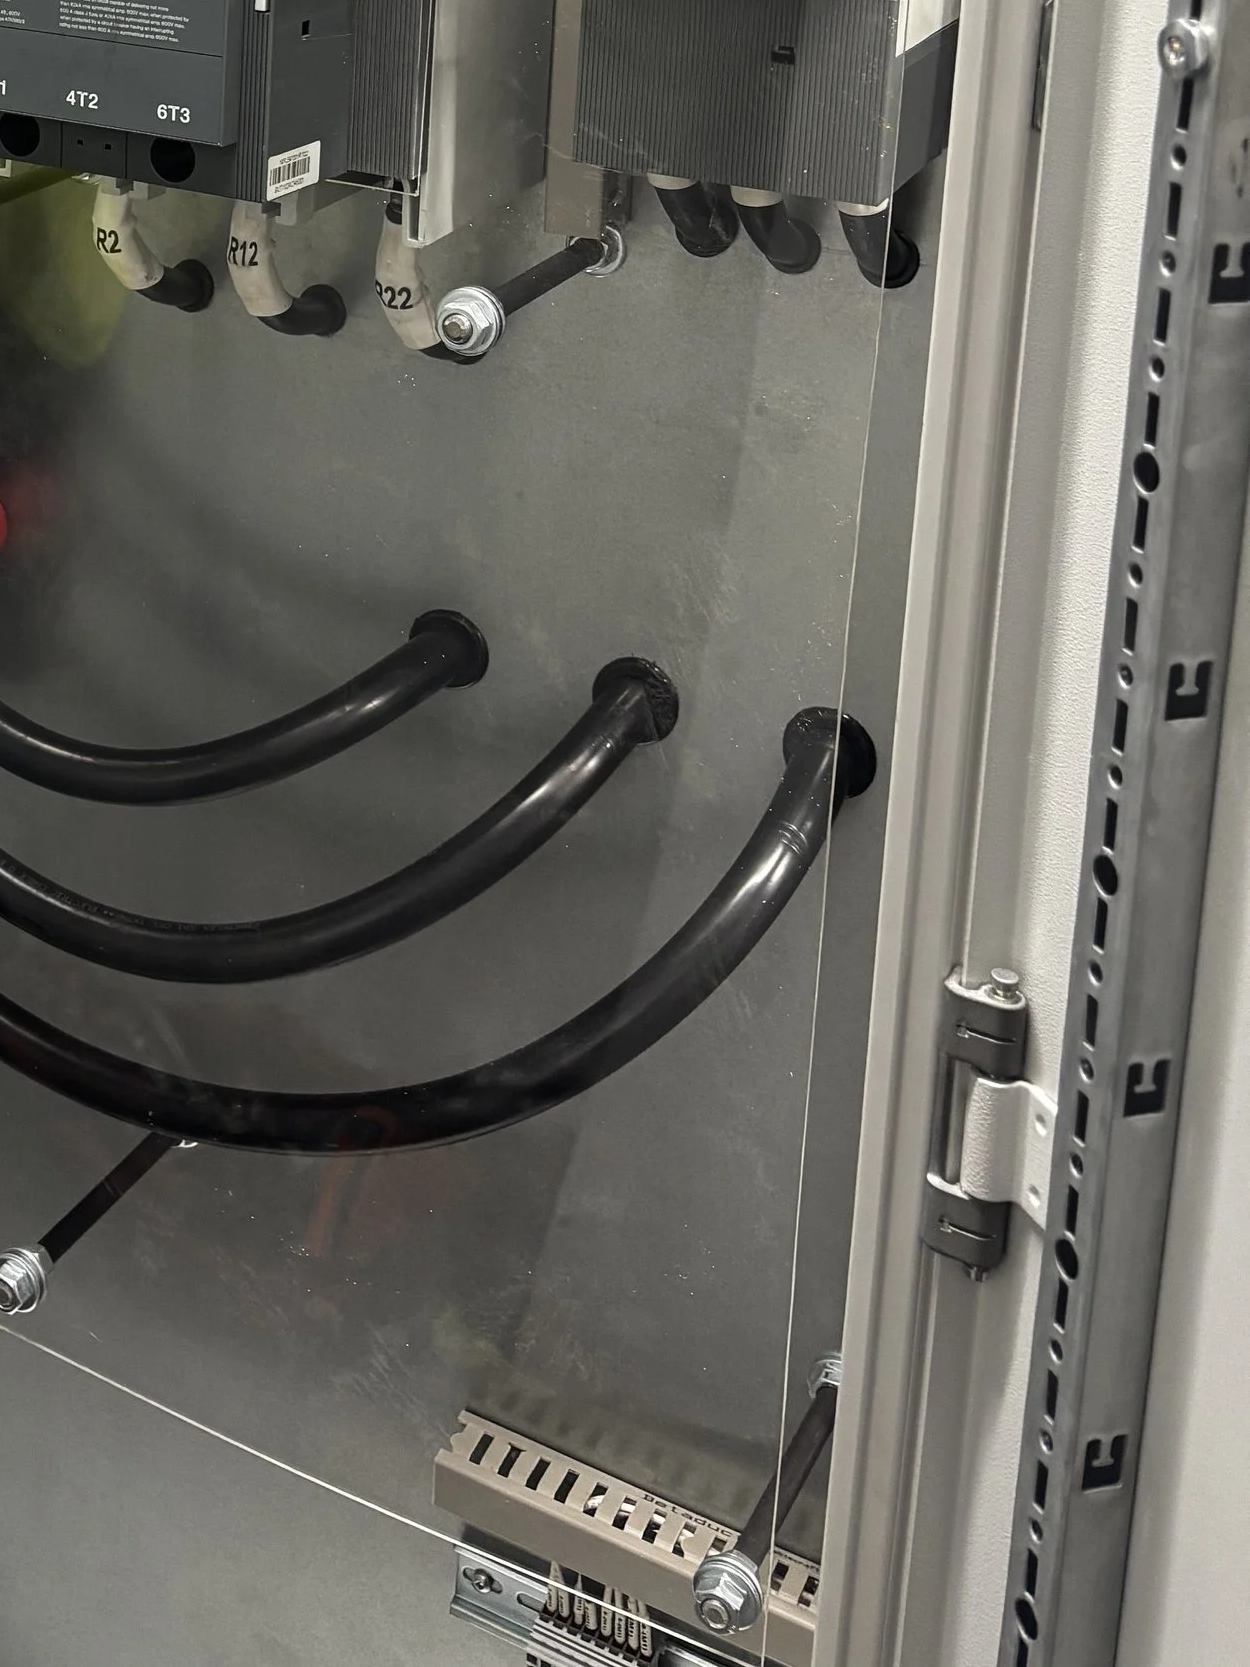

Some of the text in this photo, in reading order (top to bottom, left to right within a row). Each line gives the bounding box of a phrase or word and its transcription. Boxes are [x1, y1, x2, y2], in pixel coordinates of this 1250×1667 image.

[65, 90, 99, 110] 4T2
[156, 103, 191, 124] 6T3
[96, 227, 121, 254] R2
[227, 236, 258, 267] R12
